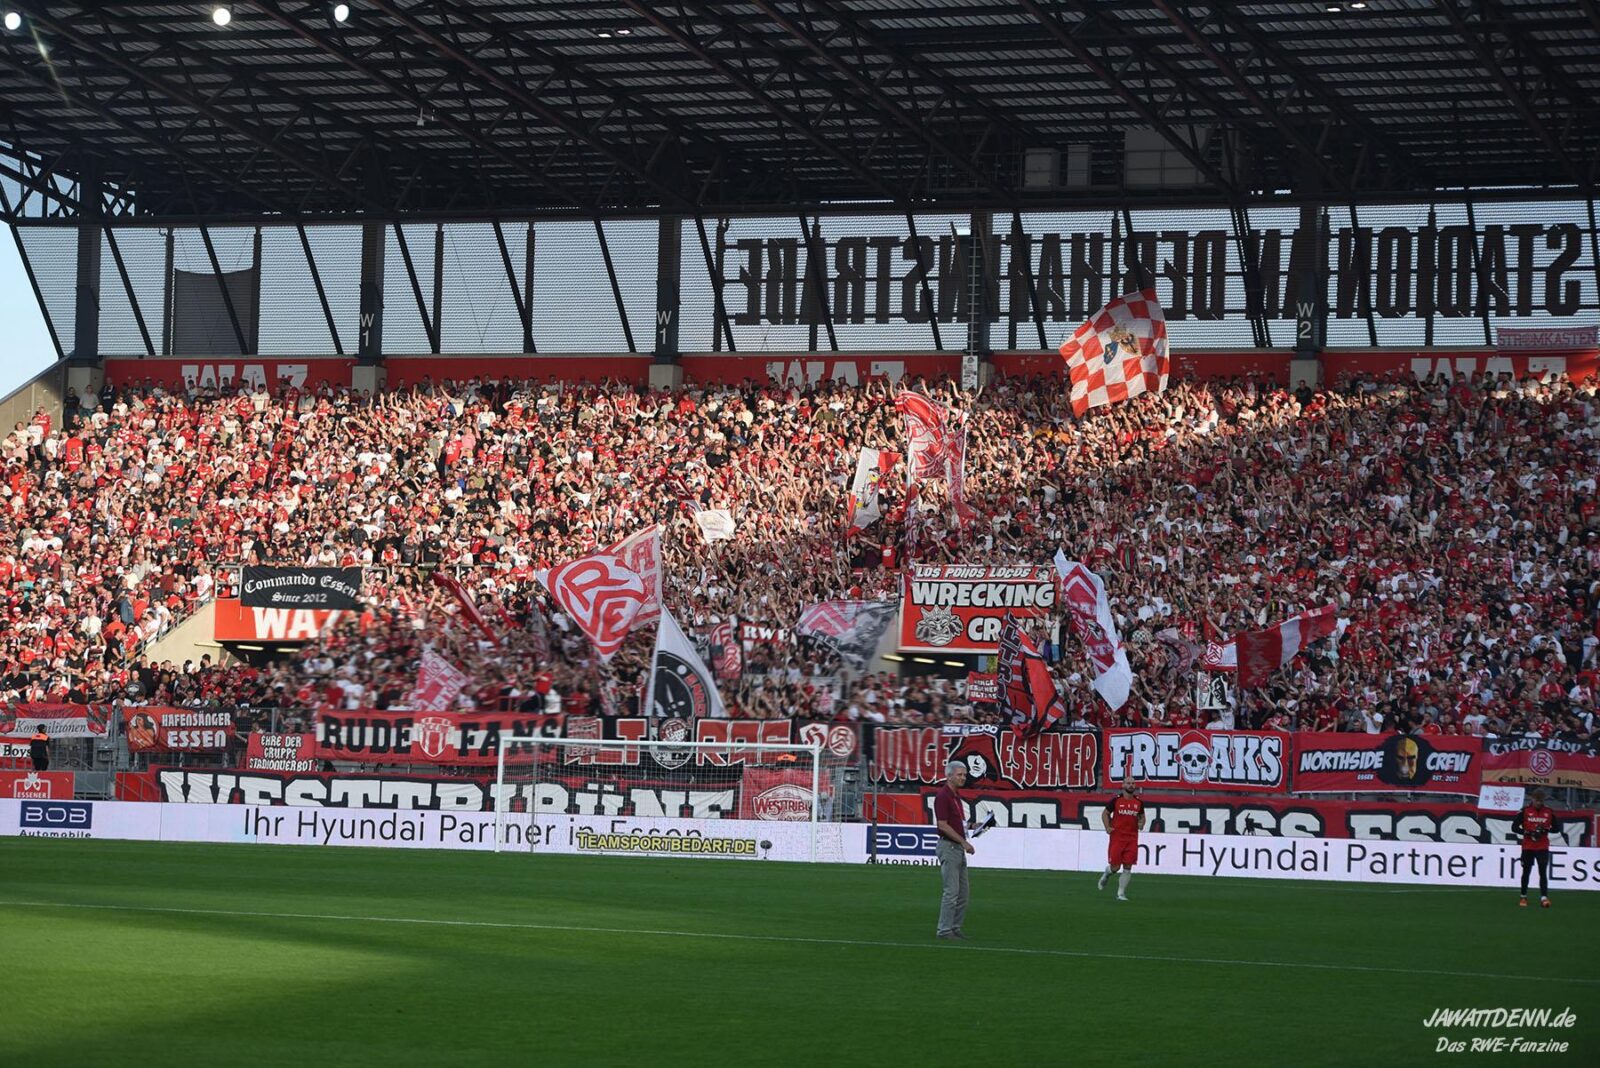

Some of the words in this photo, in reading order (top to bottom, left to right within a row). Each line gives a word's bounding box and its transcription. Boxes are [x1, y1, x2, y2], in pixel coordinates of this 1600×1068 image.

[657, 310, 672, 325] W
[1297, 302, 1314, 318] W
[360, 313, 375, 328] W
[659, 328, 667, 345] 1
[1299, 321, 1312, 339] 2
[361, 332, 370, 347] 1
[916, 567, 941, 578] LOS
[989, 567, 1031, 578] LOCOS
[244, 573, 316, 594] Commando
[320, 575, 357, 599] Essen
[912, 582, 1055, 607] WRECKING
[271, 592, 301, 603] Since
[302, 593, 328, 604] 2012
[743, 625, 791, 640] RWE
[161, 710, 231, 728] HAFENSÄNGER
[167, 730, 227, 749] ESSEN
[260, 735, 282, 747] EHRE
[285, 736, 302, 748] DER
[321, 714, 414, 755] RUDE
[458, 718, 559, 757] FANS
[264, 747, 297, 760] GRUPPE
[868, 726, 951, 784] JUNGE
[1000, 730, 1097, 788] ESSENER
[1299, 750, 1385, 772] NORTHSIDE
[1426, 752, 1472, 773] CREW
[25, 806, 87, 823] BOB
[20, 829, 92, 838] Automobile
[244, 808, 285, 837] Ihr
[297, 811, 425, 845] Hyundai
[439, 814, 557, 846] Partner
[569, 817, 595, 846] in
[576, 832, 756, 854] TEAMSPORTBEDARF.DE
[1182, 838, 1330, 875] Hyundai
[1346, 843, 1484, 879] Partner
